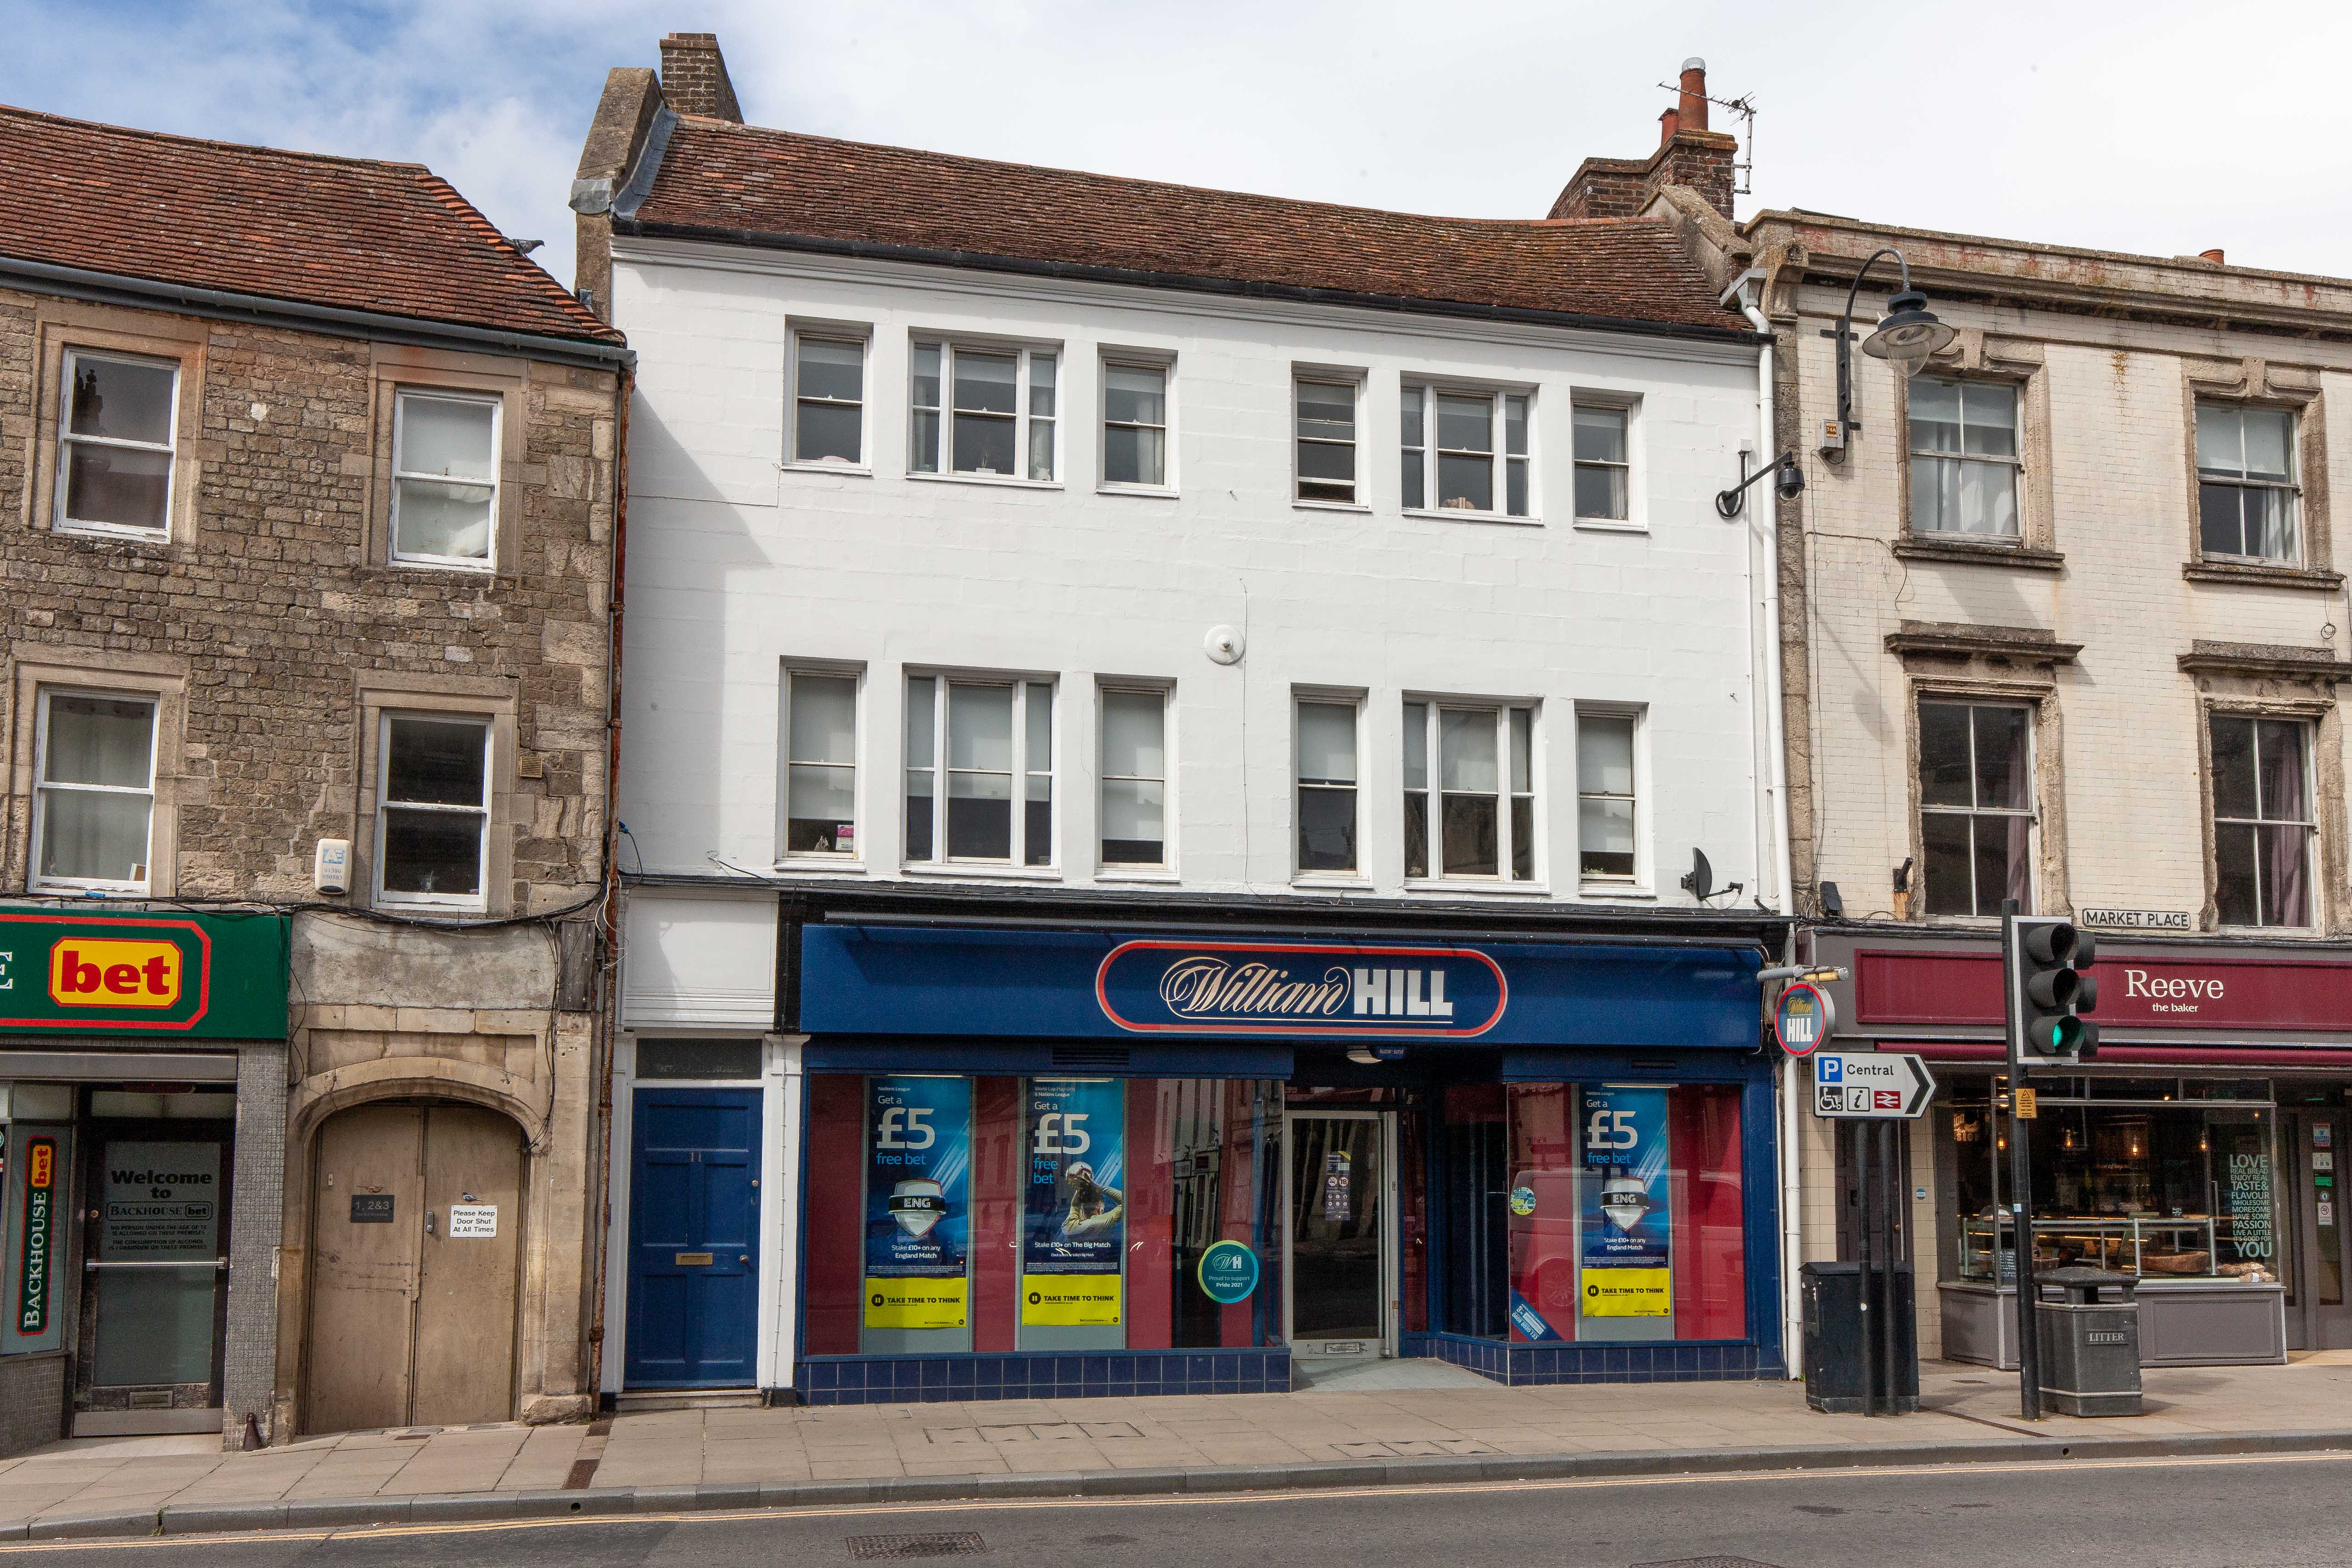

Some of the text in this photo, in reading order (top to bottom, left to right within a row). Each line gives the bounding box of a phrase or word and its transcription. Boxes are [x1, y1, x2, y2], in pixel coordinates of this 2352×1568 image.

[2086, 912, 2190, 927] MARKET PLACE
[61, 950, 170, 995] bet
[1160, 956, 1453, 1016] William HILL
[2124, 969, 2224, 999] Reeve
[1787, 997, 1814, 1015] William
[2152, 1003, 2199, 1013] the baker
[1786, 1017, 1813, 1042] HILL
[1847, 1064, 1894, 1075] Central
[878, 1096, 894, 1104] Get
[1035, 1102, 1051, 1110] Get
[877, 1107, 935, 1149] £5
[1034, 1113, 1090, 1154] £5
[1587, 1110, 1638, 1149] £5
[877, 1153, 926, 1165] free bet
[1034, 1158, 1058, 1170] free
[1588, 1153, 1631, 1164] free bet
[2229, 1154, 2268, 1168] LOVE
[111, 1170, 213, 1185] Welcome
[1034, 1172, 1054, 1184] bet
[151, 1187, 172, 1198] to
[1613, 1194, 1636, 1203] ENG
[904, 1198, 930, 1208] ENG
[110, 1206, 207, 1215] BACKHOUSE bet
[2233, 1221, 2271, 1229] PASSION
[24, 1148, 50, 1327] BACKHOUSE bet
[2235, 1242, 2272, 1257] YOU
[2089, 1333, 2124, 1341] LITTER
